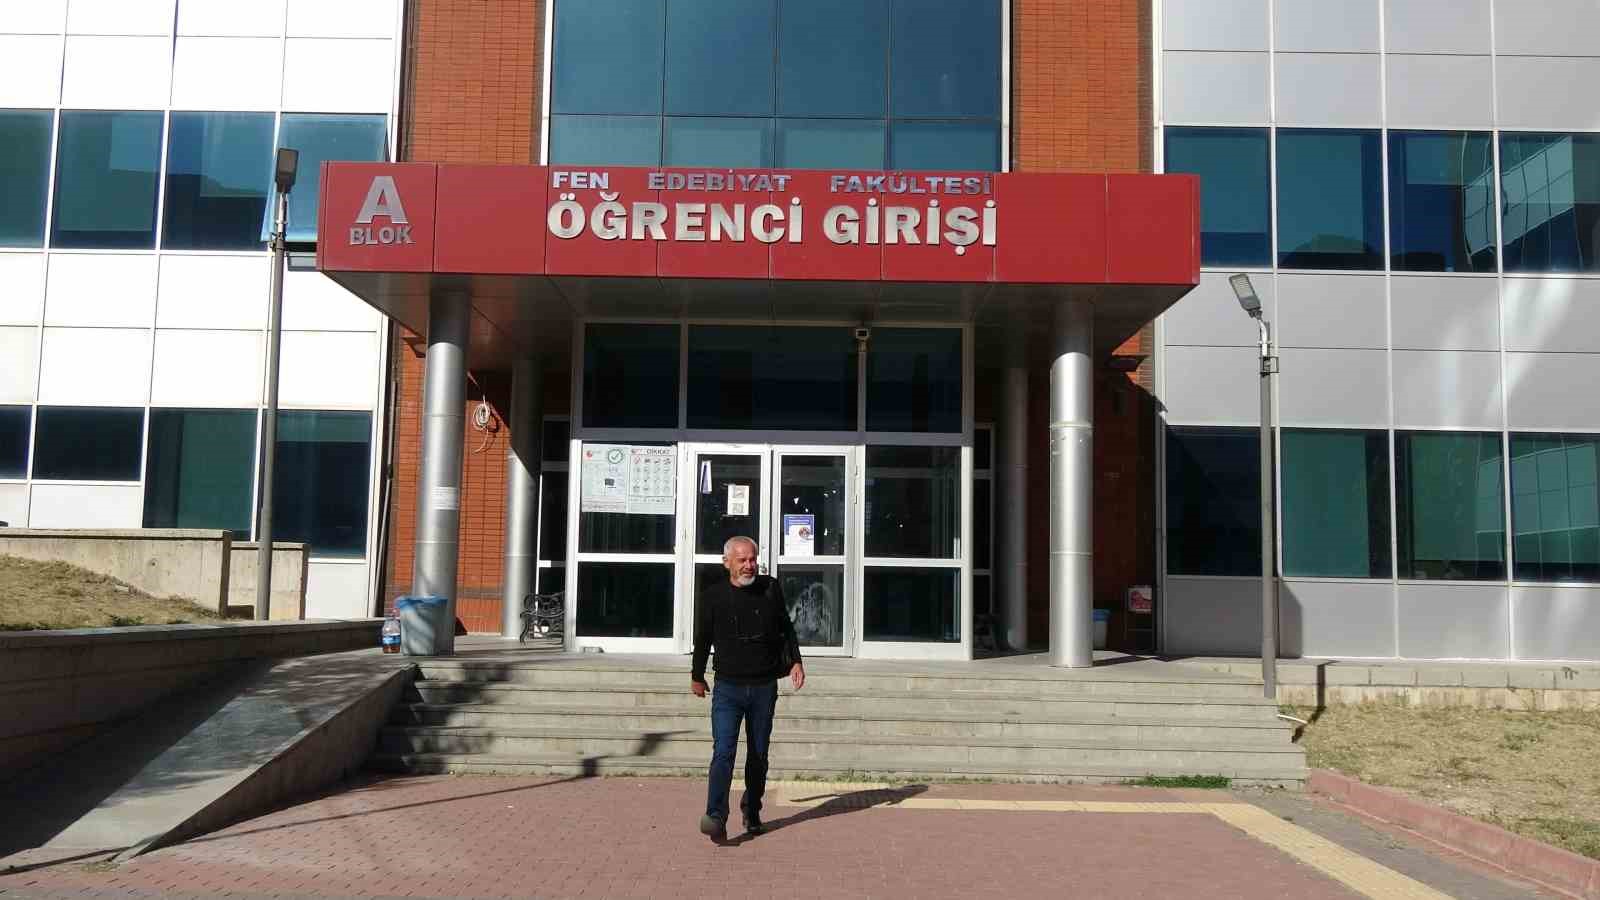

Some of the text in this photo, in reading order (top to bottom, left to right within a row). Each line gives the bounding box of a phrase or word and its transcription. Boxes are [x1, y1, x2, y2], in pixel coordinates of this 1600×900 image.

[356, 176, 408, 223] A
[552, 169, 992, 195] FEN EDEBİYAT FAKÜLTESİ
[350, 226, 416, 246] BLOK
[547, 191, 997, 256] ÖĞRENCİ GİRİŞİ
